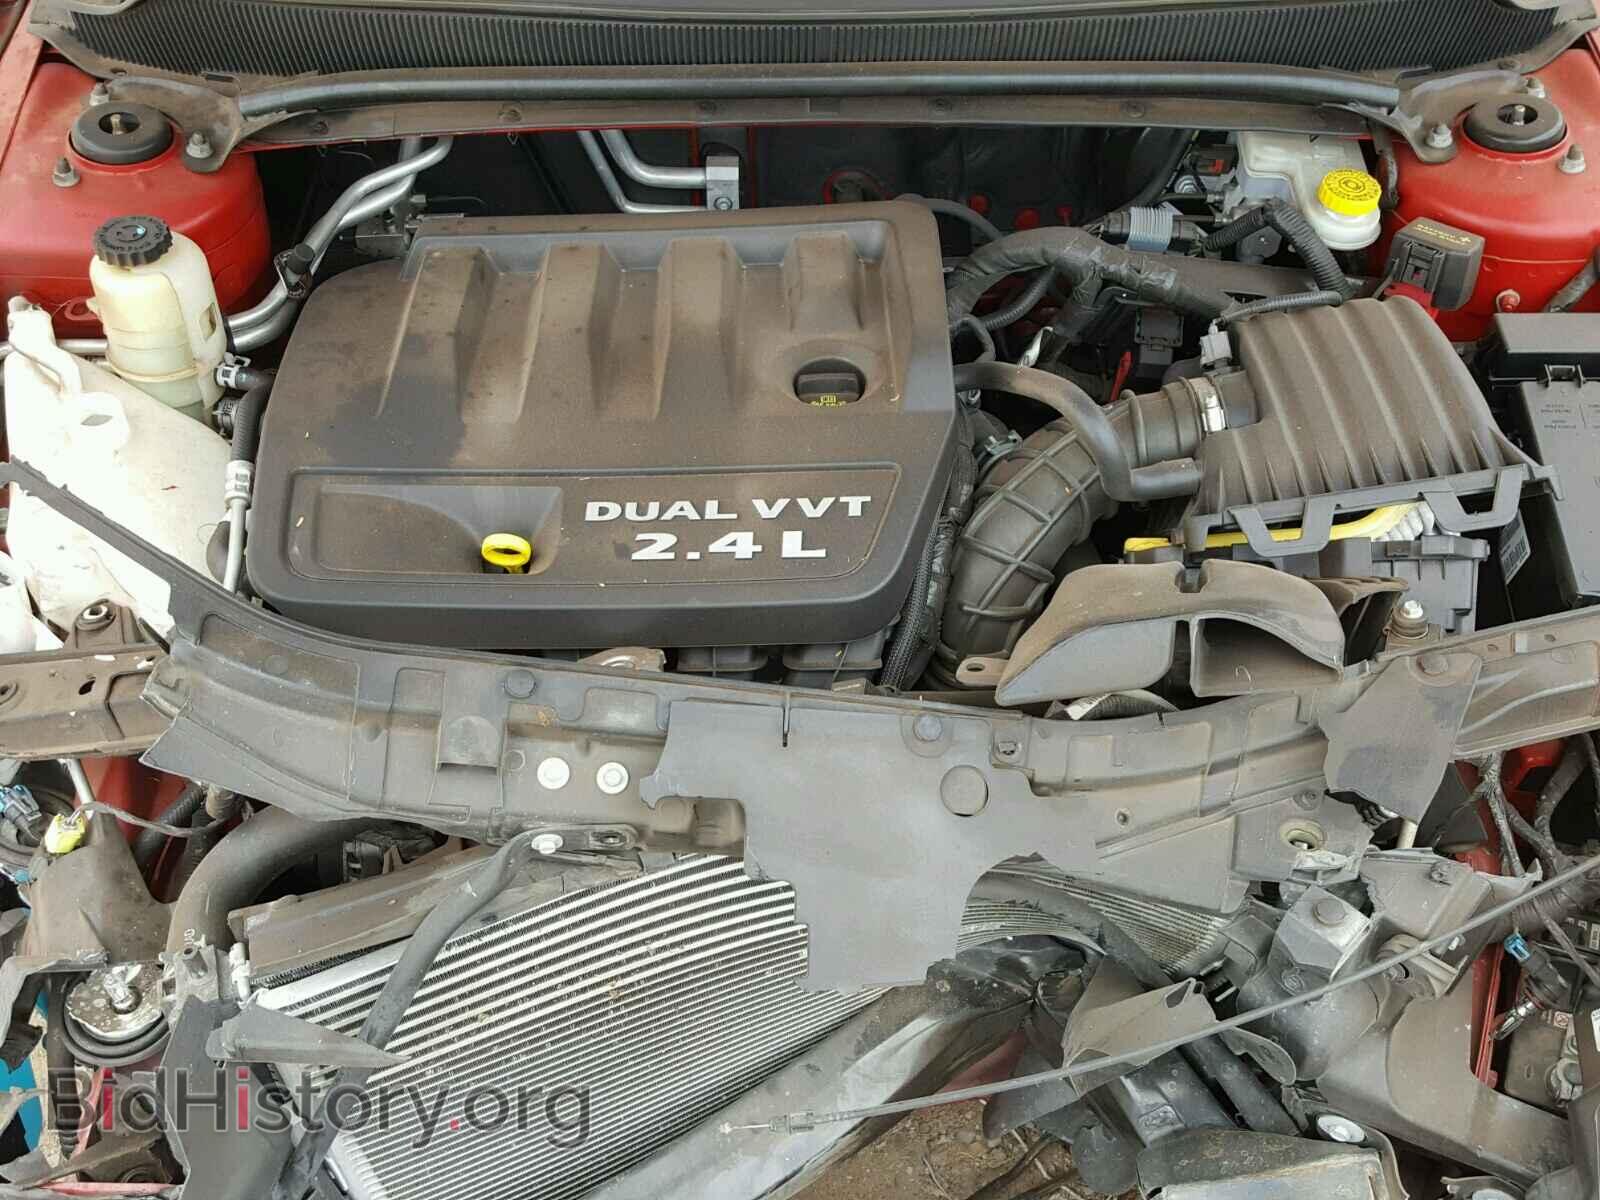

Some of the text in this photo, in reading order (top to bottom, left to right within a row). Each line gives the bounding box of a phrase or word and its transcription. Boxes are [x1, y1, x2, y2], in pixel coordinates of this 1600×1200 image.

[584, 495, 872, 521] DUAL VVT
[631, 530, 827, 561] 2.4 L
